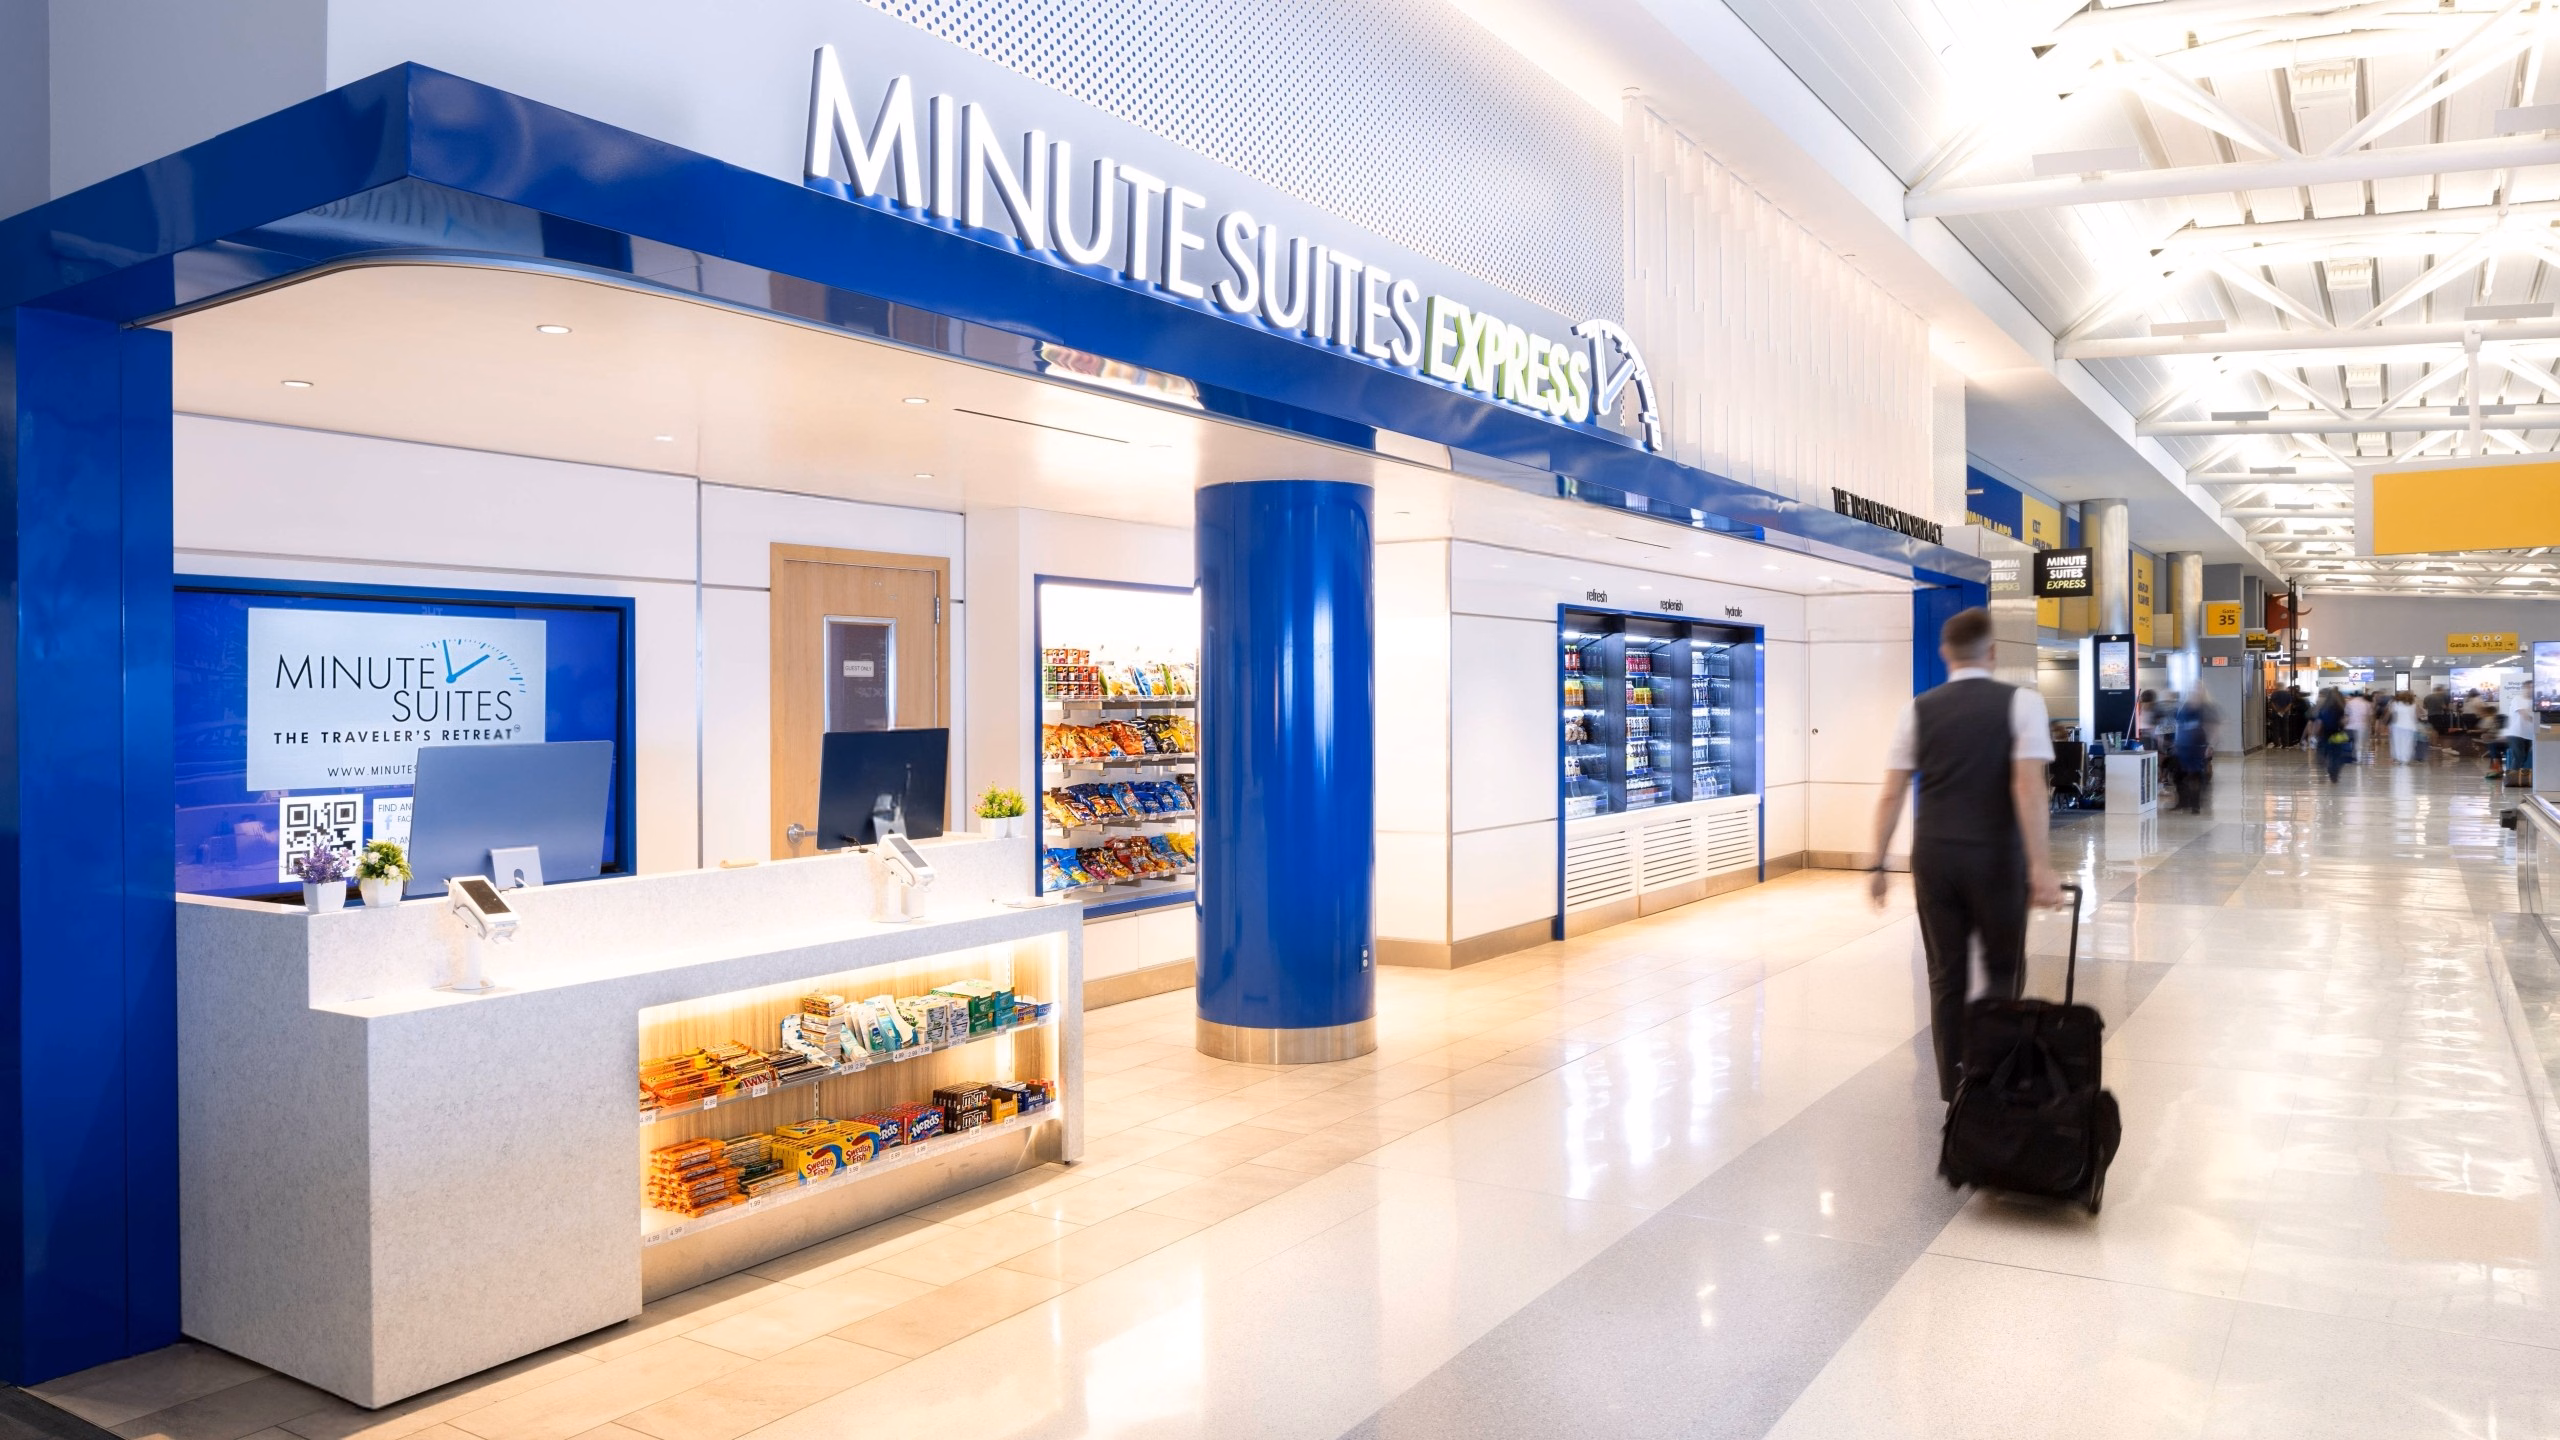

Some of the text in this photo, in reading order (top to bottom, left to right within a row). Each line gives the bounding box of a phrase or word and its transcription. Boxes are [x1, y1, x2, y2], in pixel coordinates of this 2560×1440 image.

[803, 44, 1590, 424] MINUTE SUITES EXPRESS
[1831, 487, 1850, 516] THE
[1898, 511, 1944, 546] WORKPLACE
[2046, 555, 2087, 567] MINUTE
[2049, 568, 2083, 580] SUITES
[2046, 579, 2087, 590] EXPRESS
[1586, 589, 1608, 603] refresh
[1660, 599, 1684, 613] replenish
[1725, 605, 1743, 618] hydrate
[2219, 614, 2236, 626] 35
[275, 654, 435, 690] MINUTE
[392, 690, 513, 723] SUITES
[274, 732, 309, 744] THE
[321, 730, 431, 744] TRAVELER'S
[378, 803, 397, 812] FIND
[846, 1144, 871, 1161] Swedish
[852, 1153, 866, 1163] Fish
[806, 1157, 834, 1175] Swedish
[813, 1167, 829, 1177] Fish
[750, 1200, 761, 1208] 1.99
[669, 1227, 682, 1236] 4.99
[647, 1235, 660, 1243] 4.99
